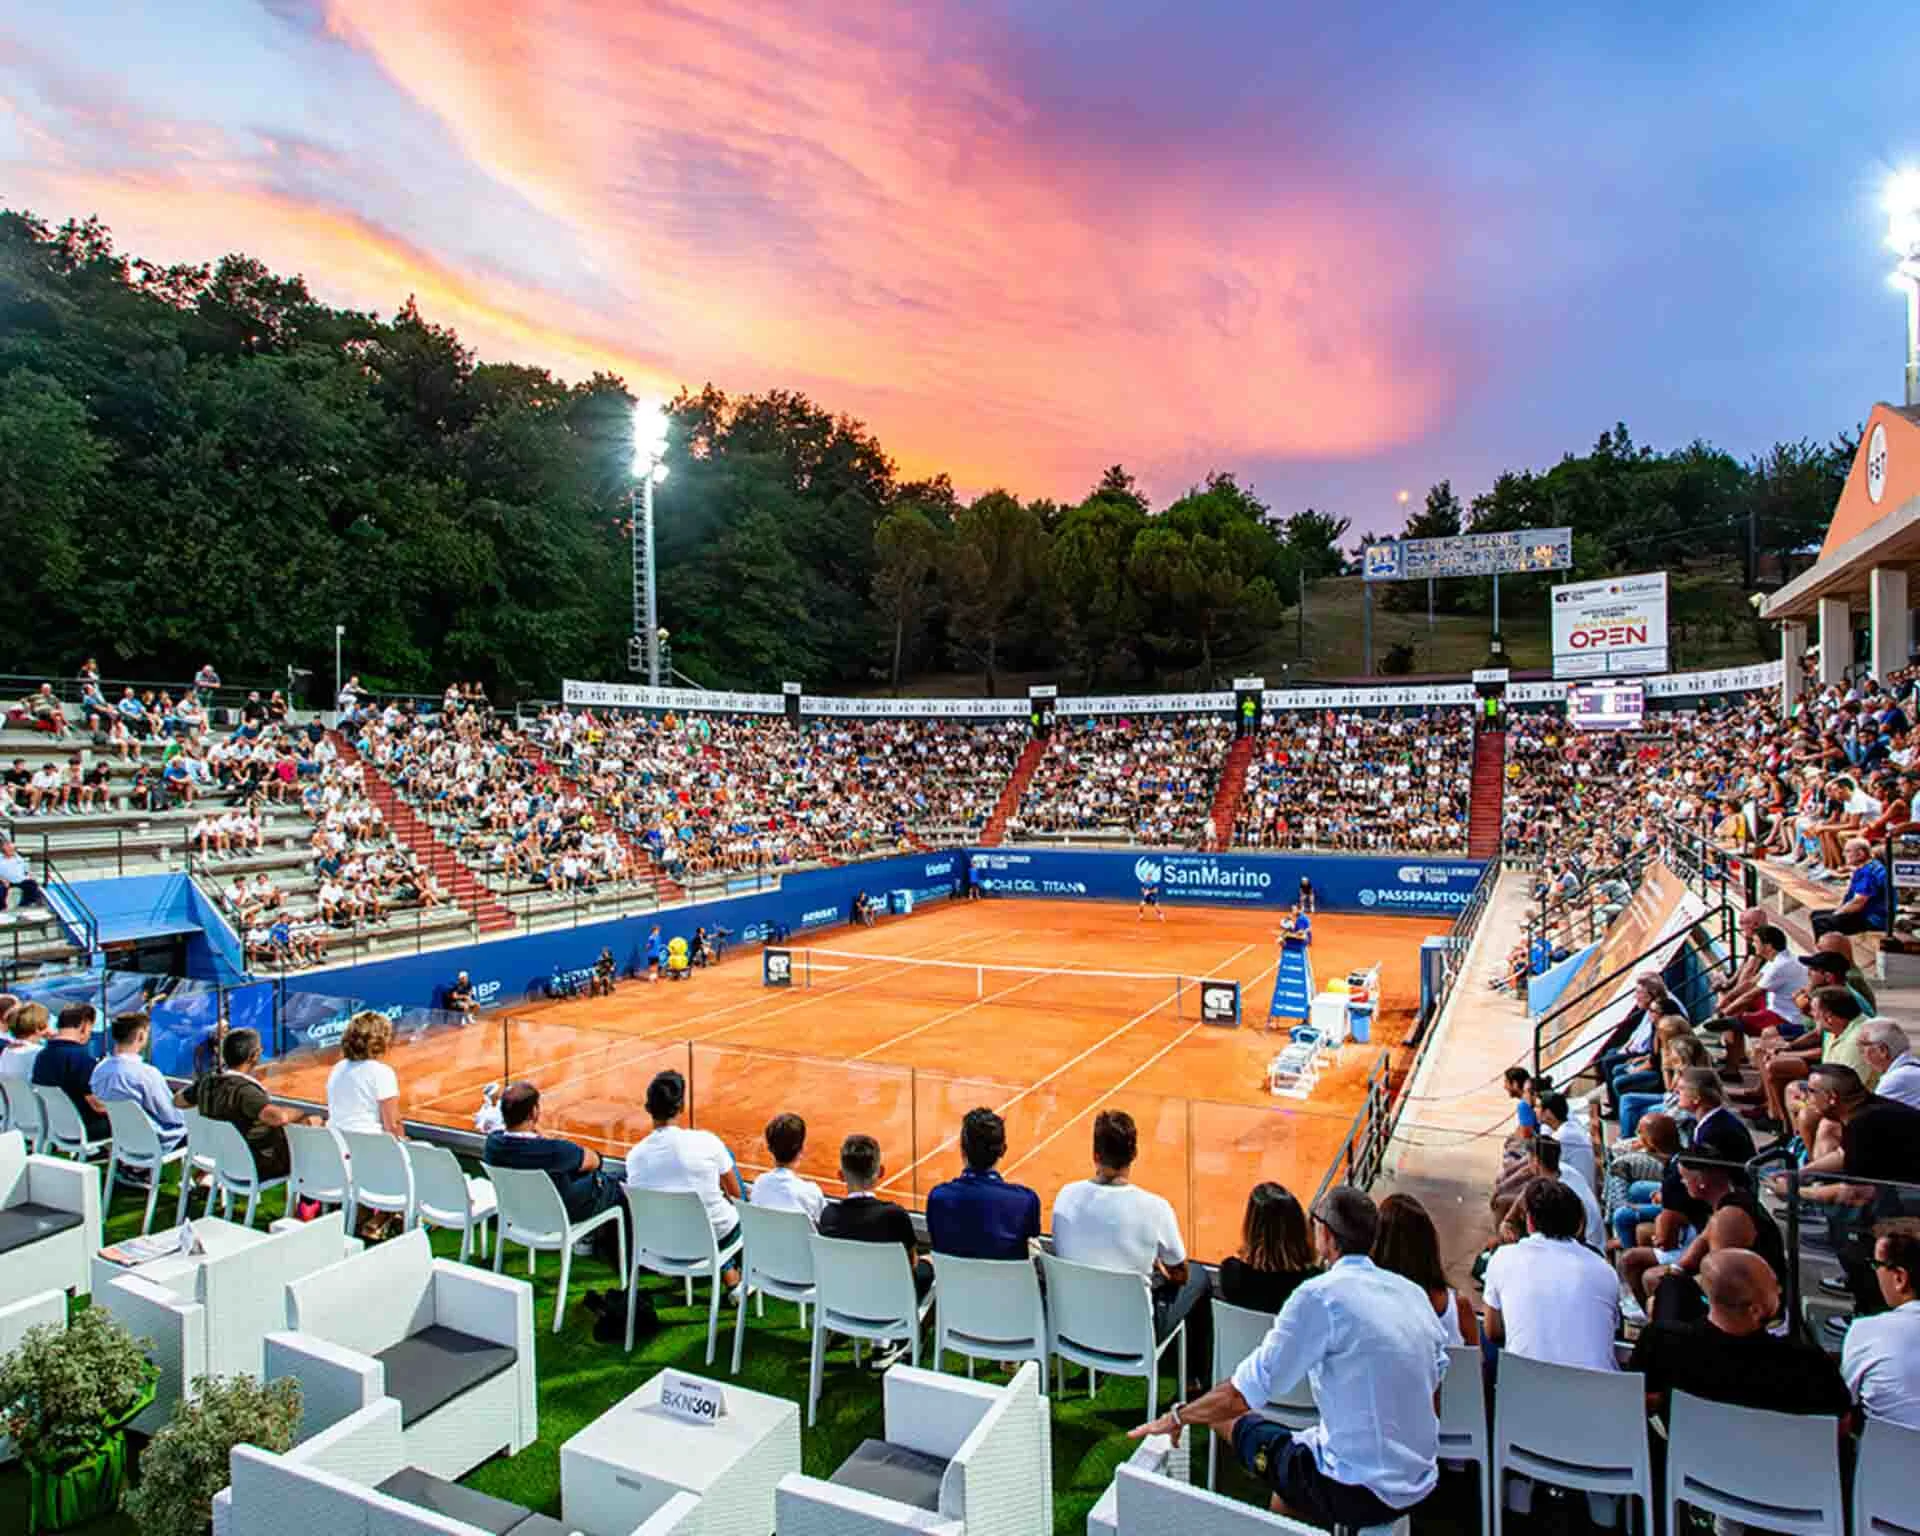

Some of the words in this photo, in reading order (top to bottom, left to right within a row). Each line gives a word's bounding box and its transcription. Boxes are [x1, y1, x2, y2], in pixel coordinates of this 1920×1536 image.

[1569, 625, 1648, 649] OPEN
[1163, 864, 1272, 888] SanMarino
[1378, 888, 1474, 904] PASSEPARTOU
[662, 1389, 717, 1418] BKN301
